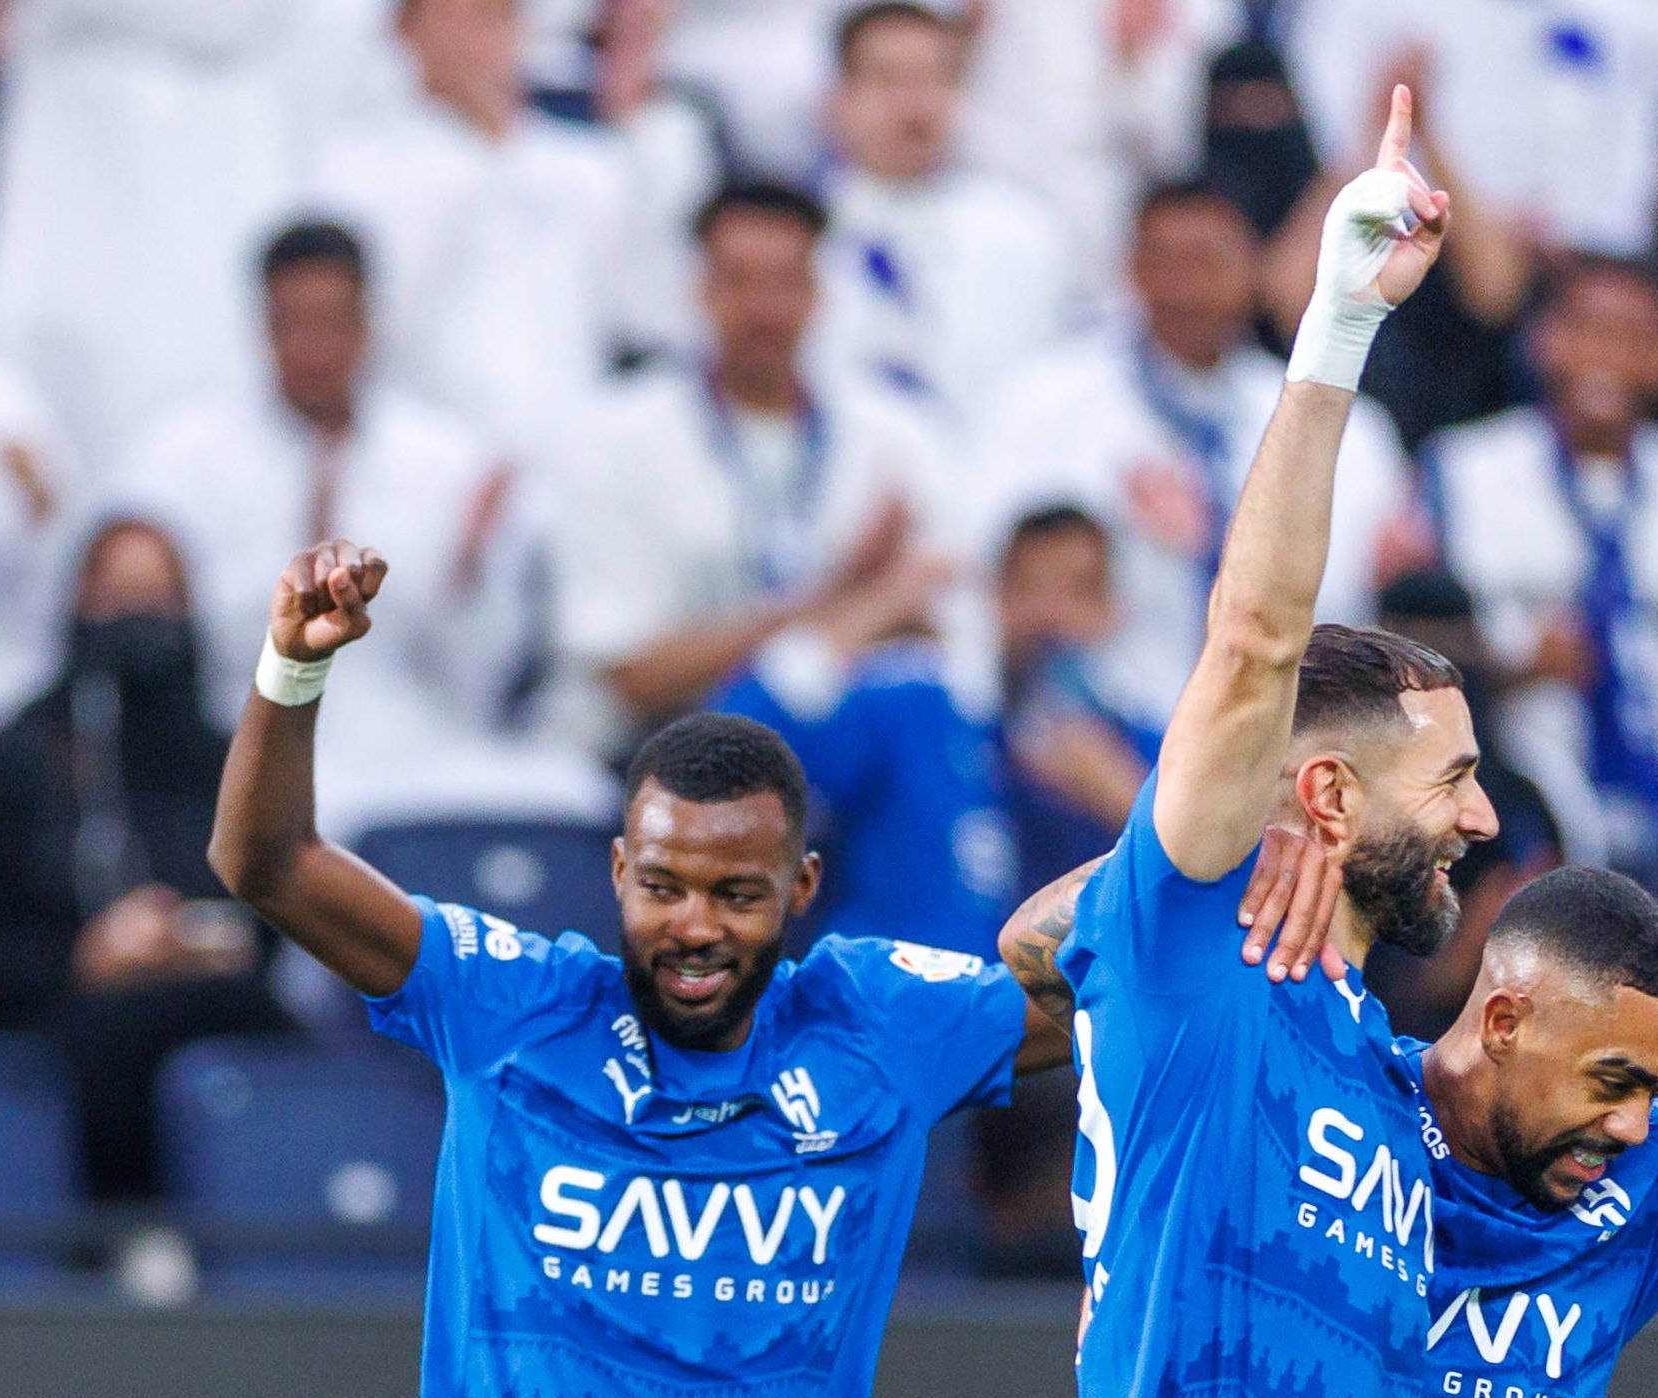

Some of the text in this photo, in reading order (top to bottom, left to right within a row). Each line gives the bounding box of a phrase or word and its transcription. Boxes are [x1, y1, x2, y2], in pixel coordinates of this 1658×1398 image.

[533, 1164, 846, 1266] SAVVY
[1296, 1201, 1410, 1283] GAMES
[542, 1255, 694, 1300] GAMES
